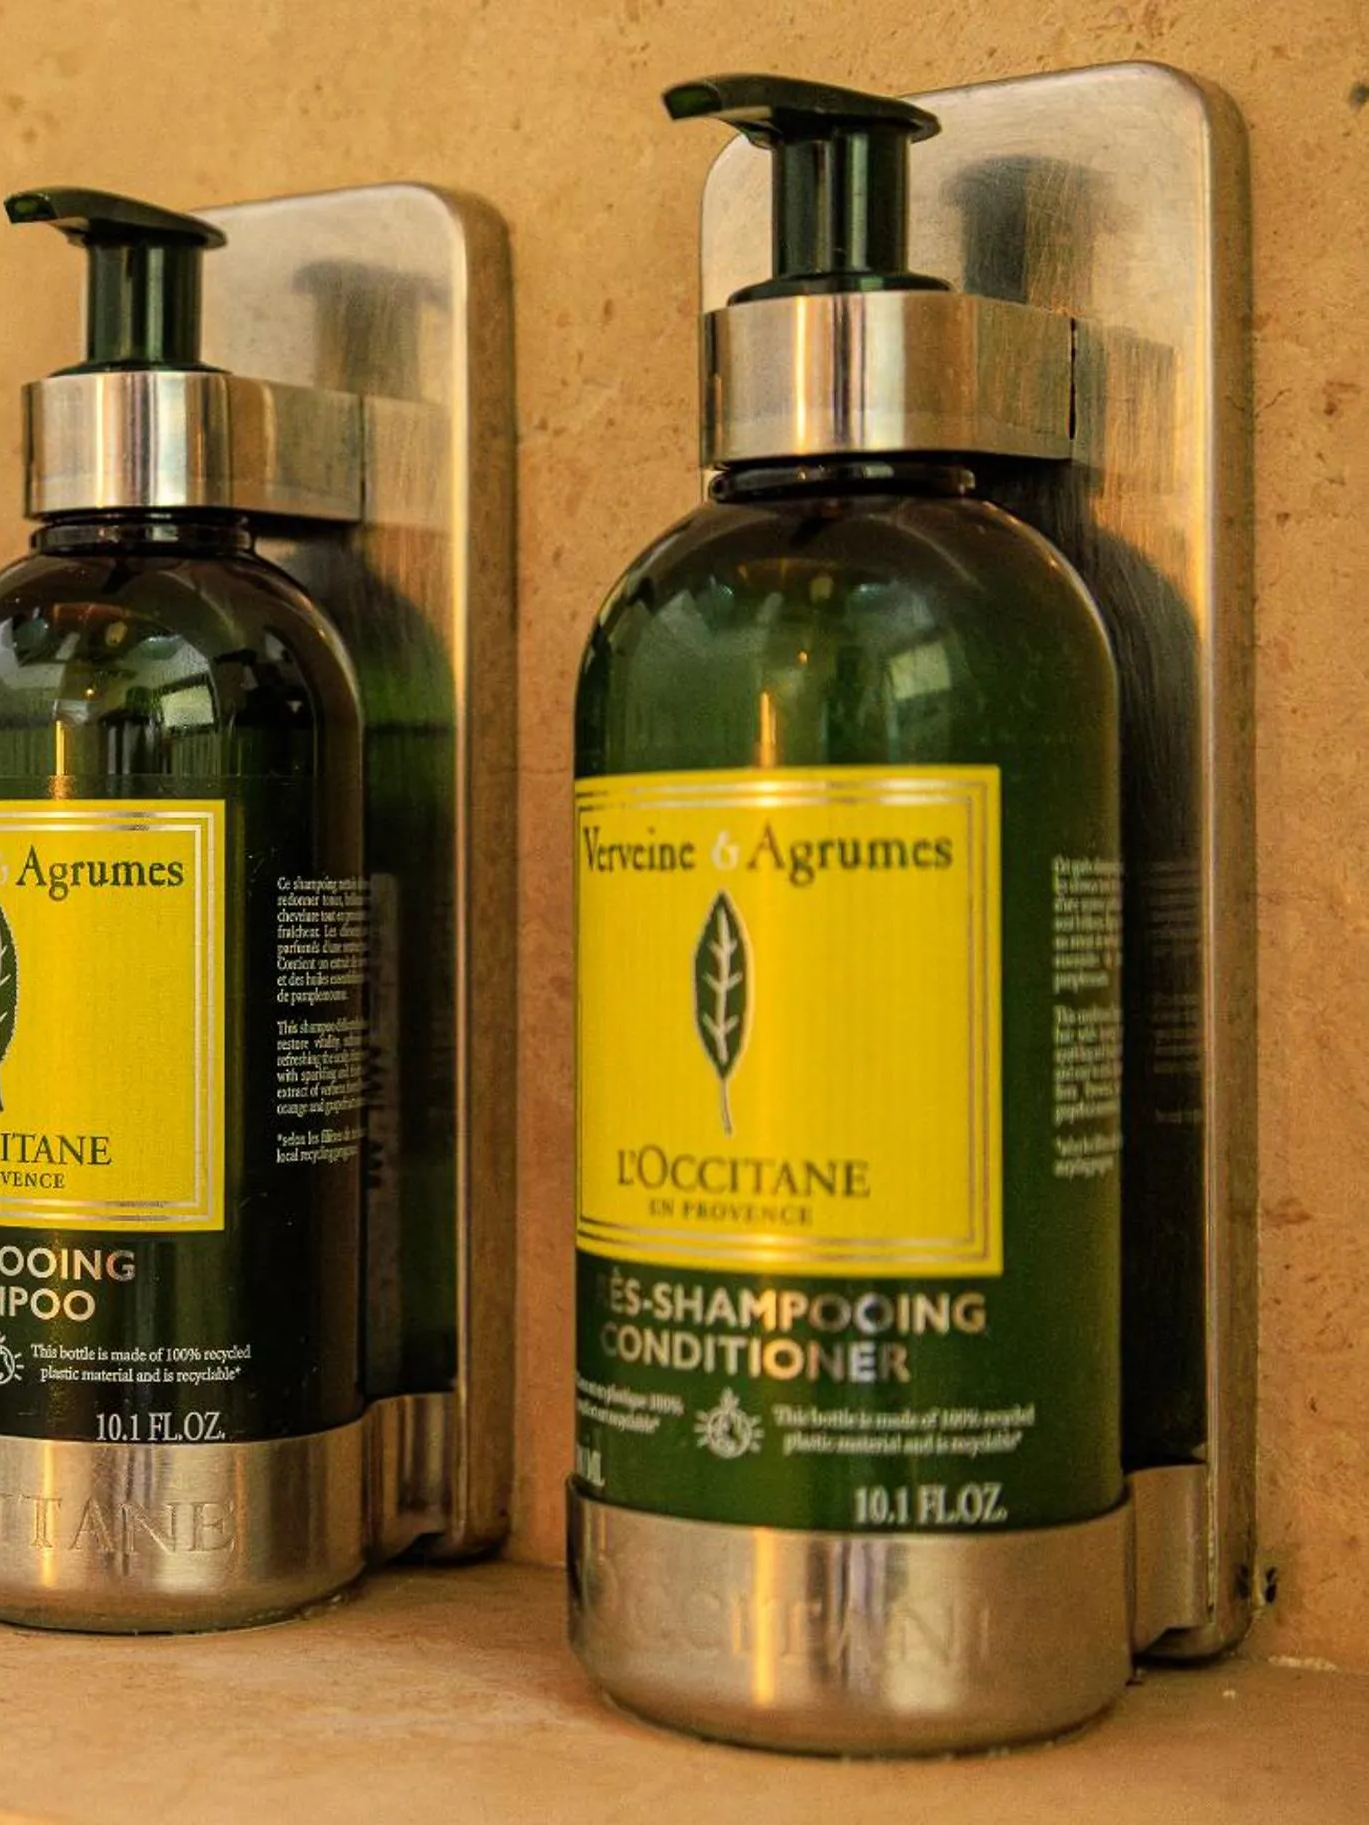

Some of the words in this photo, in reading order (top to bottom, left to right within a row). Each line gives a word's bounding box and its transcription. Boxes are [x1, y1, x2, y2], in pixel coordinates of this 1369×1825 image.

[584, 826, 696, 873] Verveine
[747, 820, 954, 887] Agrumes
[16, 845, 184, 901] Agrumes
[277, 989, 289, 1002] de
[277, 1020, 298, 1035] This
[277, 1068, 298, 1082] with
[617, 1145, 871, 1198] L'OCCITANE
[683, 1201, 813, 1227] PROVENCE
[31, 1344, 57, 1359] This
[60, 1345, 95, 1361] bottle
[98, 1347, 108, 1361] is
[111, 1347, 146, 1362] made
[149, 1347, 163, 1362] of
[165, 1348, 201, 1362] 100%
[204, 1345, 252, 1363] recycled
[601, 1321, 911, 1384] CONDITIONER
[40, 1366, 79, 1382] plastic
[82, 1368, 133, 1382] material
[136, 1368, 161, 1382] and
[164, 1368, 174, 1382] is
[96, 1412, 141, 1441] 10.1
[876, 1410, 918, 1428] made
[854, 1486, 911, 1525] 10.1
